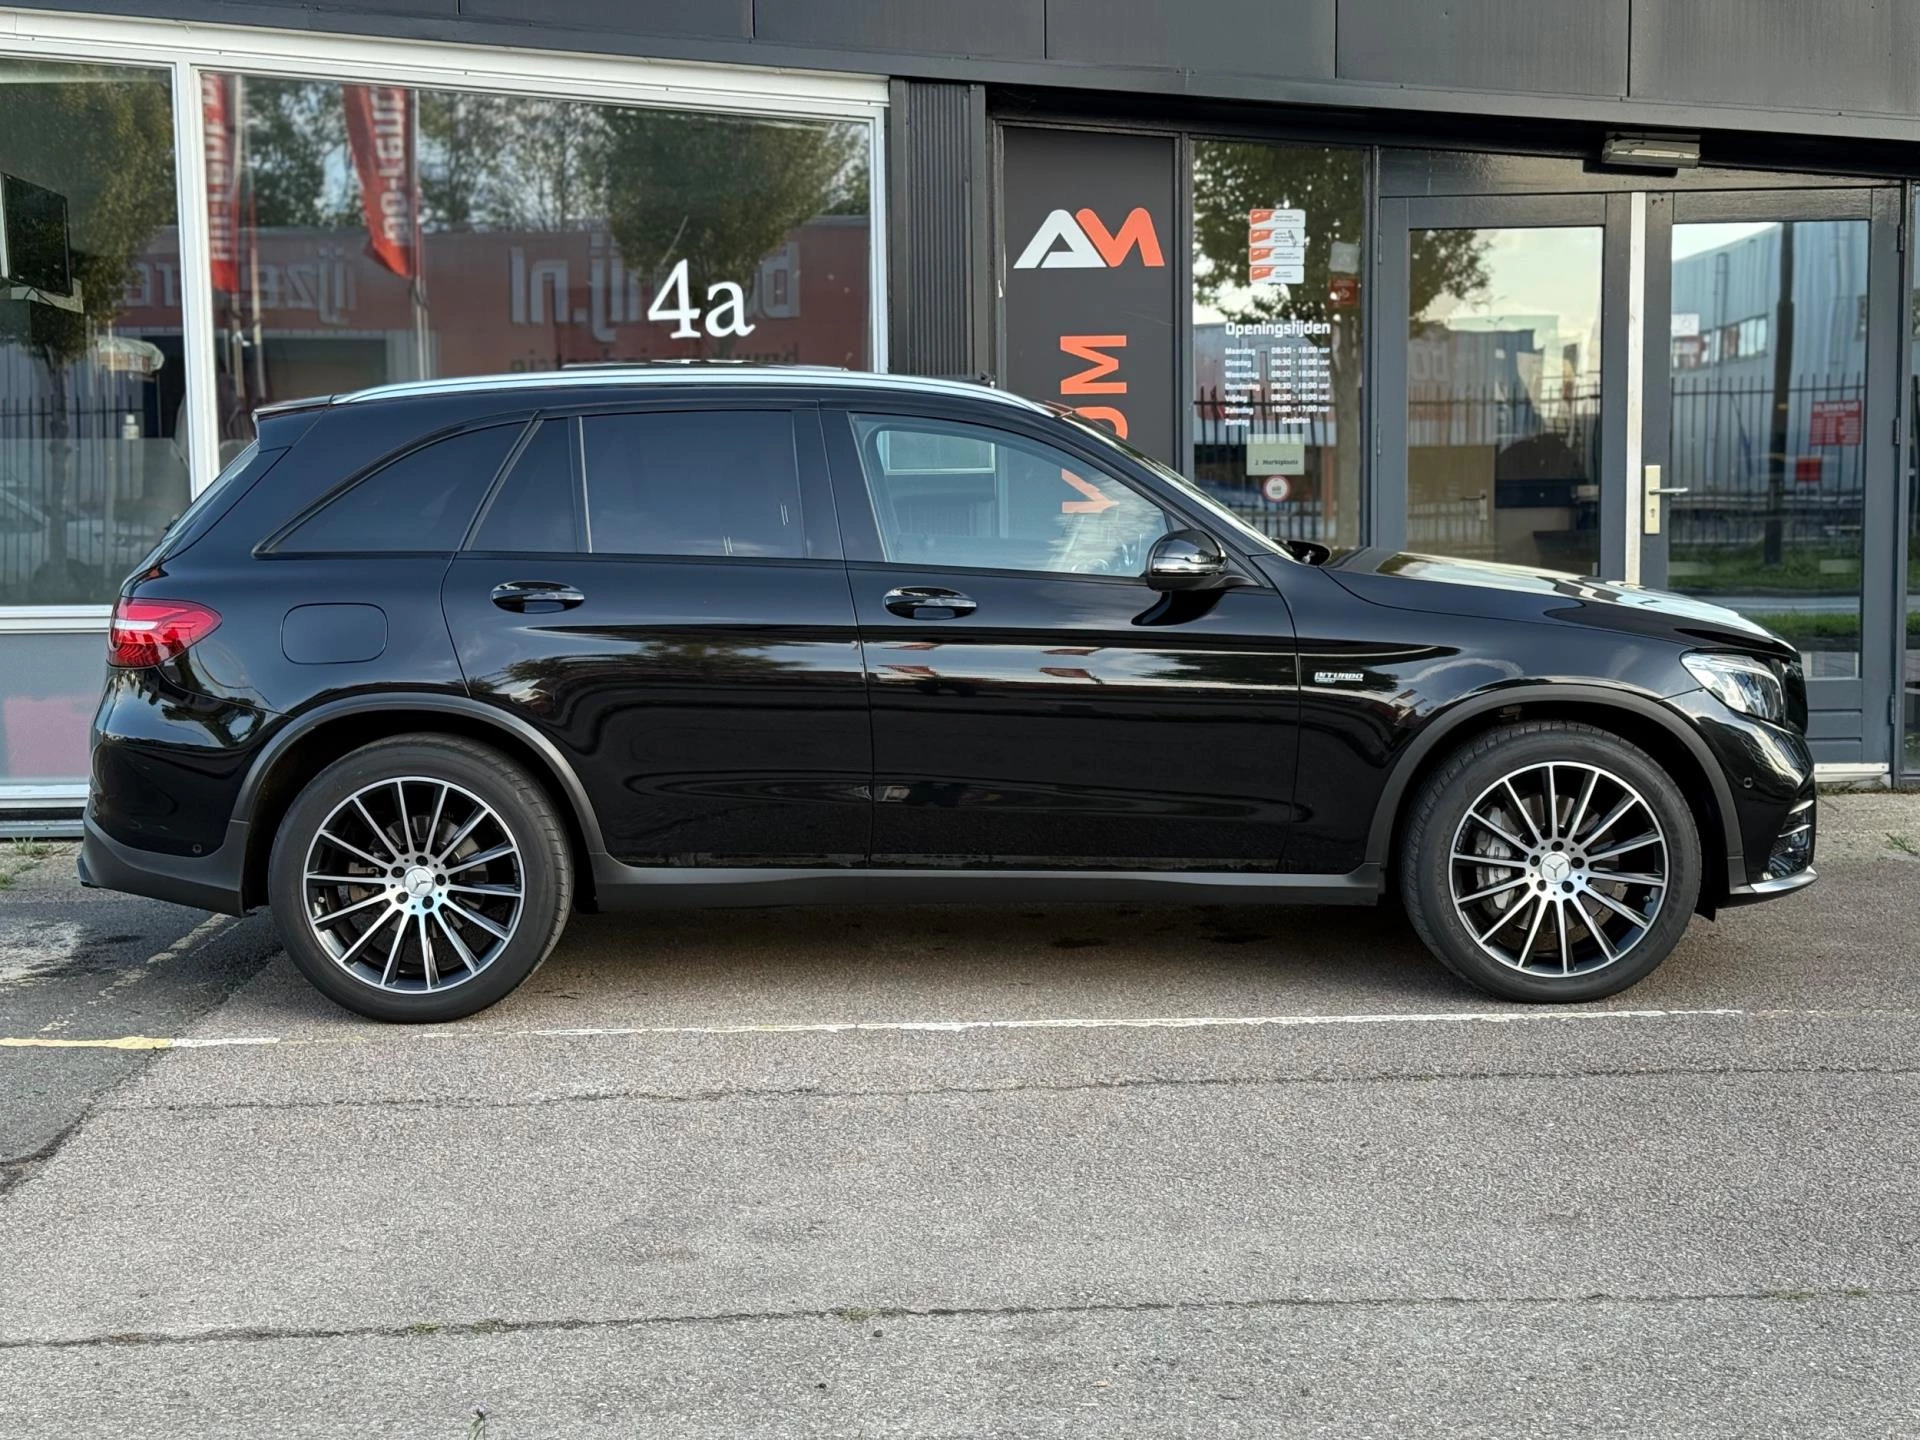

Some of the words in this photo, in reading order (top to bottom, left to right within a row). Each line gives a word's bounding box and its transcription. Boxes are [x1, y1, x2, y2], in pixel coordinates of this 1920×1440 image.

[1013, 207, 1165, 269] AM
[647, 259, 756, 339] 4a
[1225, 320, 1330, 338] Openingstijden
